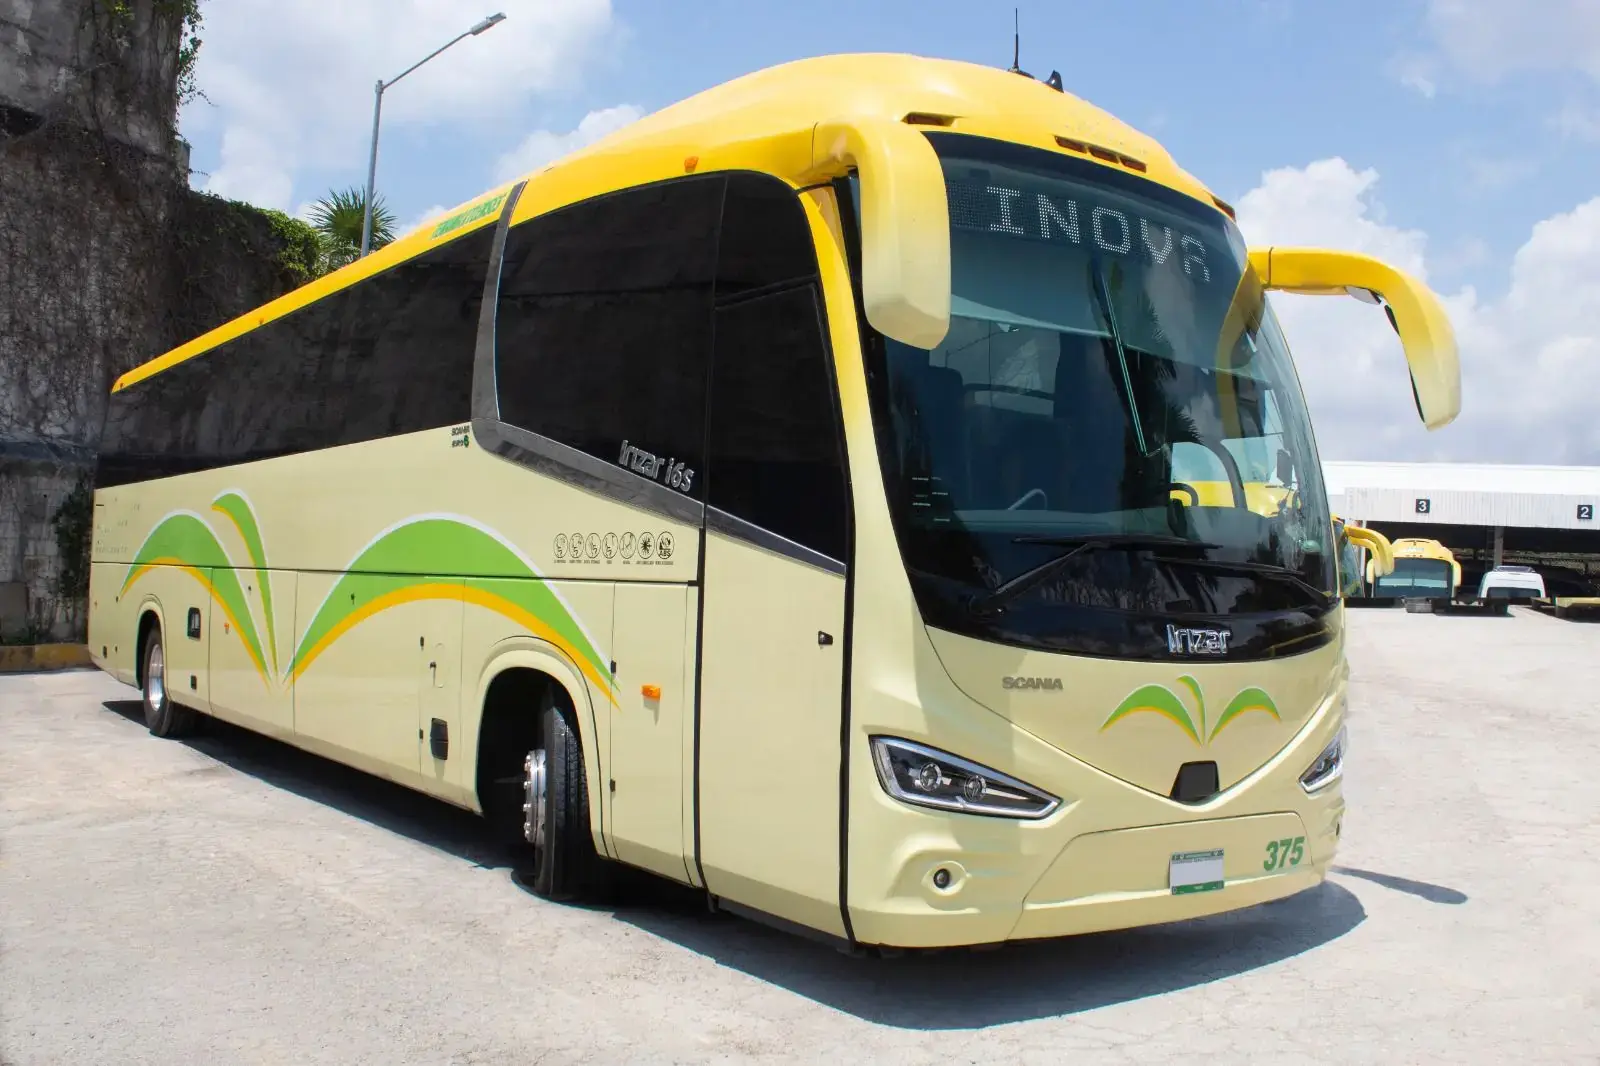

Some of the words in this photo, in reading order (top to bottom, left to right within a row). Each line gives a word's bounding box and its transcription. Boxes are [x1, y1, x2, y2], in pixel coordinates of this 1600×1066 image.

[665, 457, 695, 492] i6s
[1418, 500, 1427, 512] 3
[1580, 506, 1589, 518] 2
[1166, 624, 1231, 654] Irizar
[1002, 676, 1064, 690] SCANIA
[1263, 836, 1305, 871] 375
